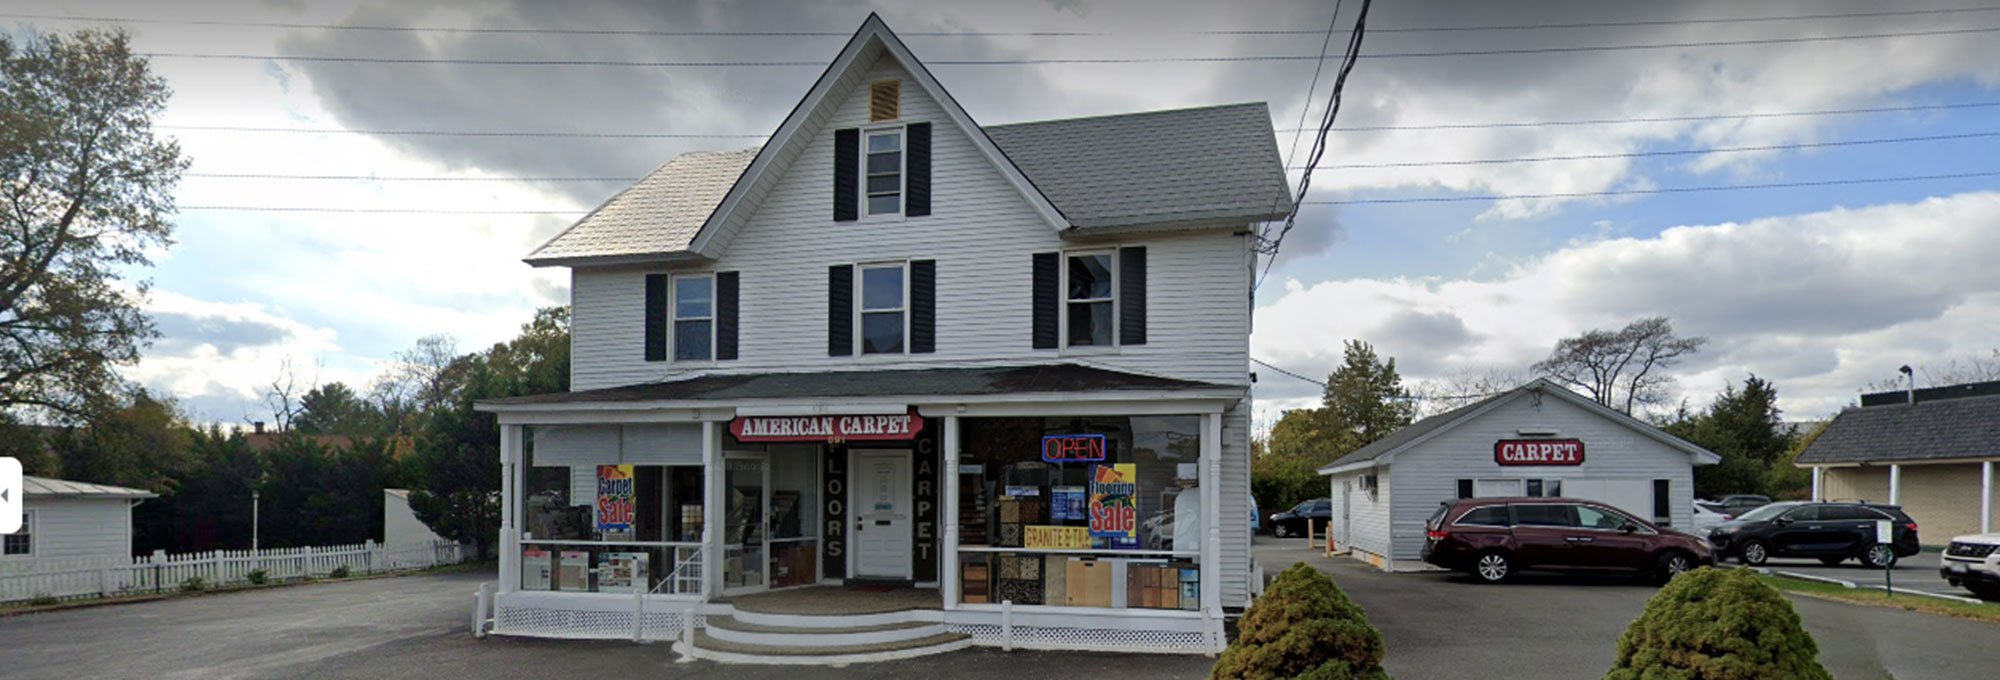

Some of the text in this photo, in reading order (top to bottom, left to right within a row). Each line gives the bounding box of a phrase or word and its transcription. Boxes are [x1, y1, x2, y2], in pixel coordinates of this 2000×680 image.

[741, 415, 911, 436] AMERICAN CARPET
[1045, 438, 1105, 459] OPEN
[1503, 443, 1577, 461] CARPET
[599, 476, 632, 496] Carpet
[1090, 481, 1134, 495] Flooring
[918, 439, 931, 560] CARPET
[599, 497, 634, 525] Sale
[1091, 499, 1134, 532] Sale
[1026, 527, 1063, 547] GRANITE
